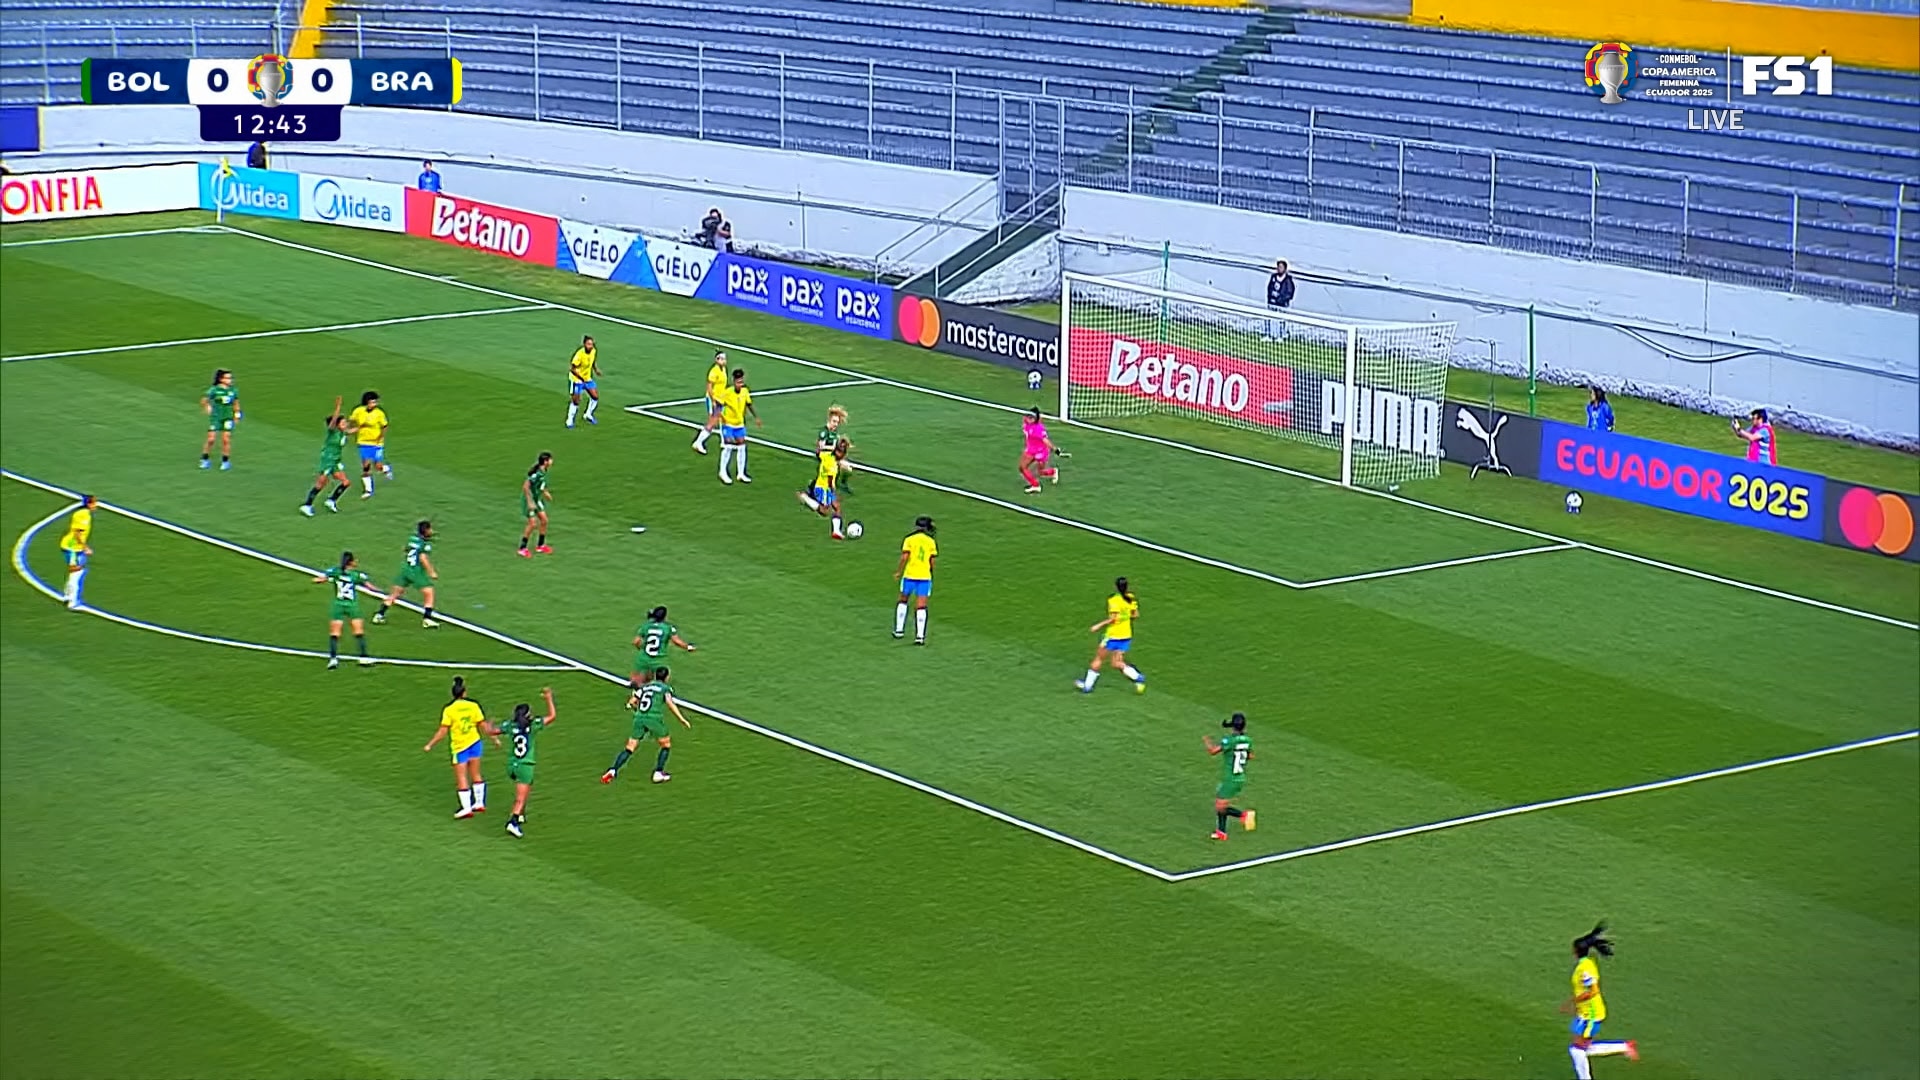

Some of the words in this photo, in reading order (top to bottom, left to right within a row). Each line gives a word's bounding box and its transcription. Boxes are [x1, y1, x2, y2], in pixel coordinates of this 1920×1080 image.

[213, 172, 289, 211] Midea
[316, 181, 392, 222] Midea
[431, 196, 530, 257] Betano
[573, 237, 619, 264] CIELO
[655, 254, 702, 282] CIELO
[727, 263, 769, 296] pax
[781, 274, 824, 308] pax
[836, 286, 880, 320] pax
[946, 320, 1059, 366] mastercard
[1107, 339, 1250, 412] Betano
[1321, 379, 1439, 457] PUMA
[1556, 438, 1723, 504] ECUADOR
[1728, 474, 1809, 520] 2025
[645, 635, 661, 656] 2
[513, 735, 528, 757] 3
